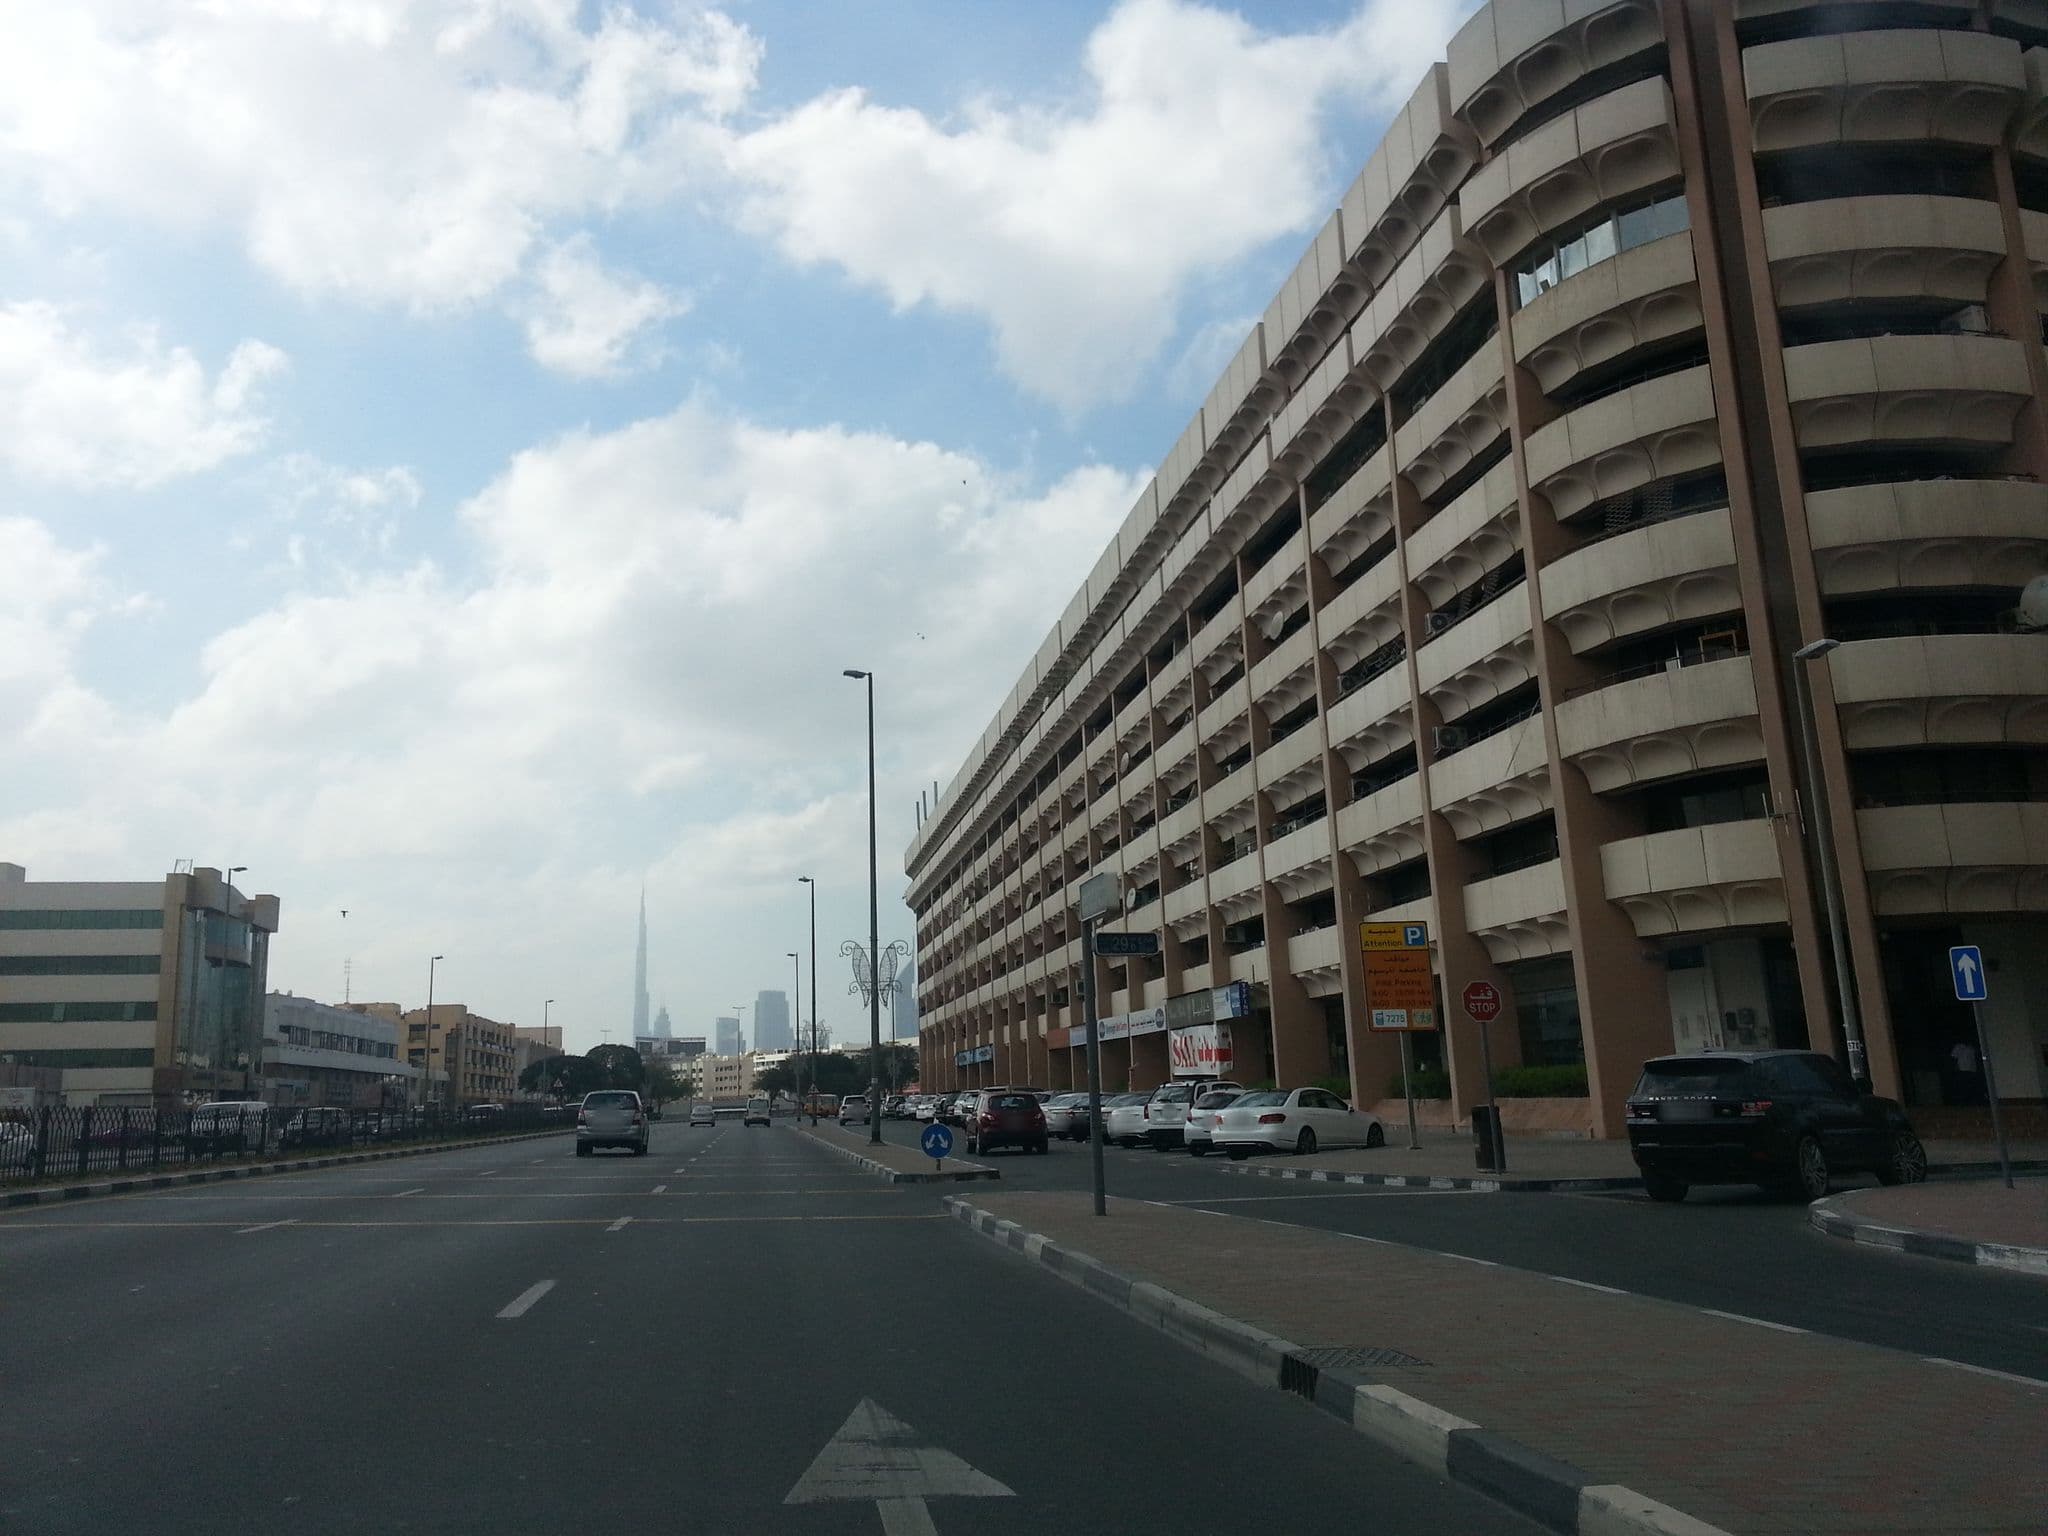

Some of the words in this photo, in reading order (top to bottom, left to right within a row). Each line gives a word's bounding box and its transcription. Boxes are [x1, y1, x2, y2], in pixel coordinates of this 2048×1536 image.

[1407, 927, 1421, 944] P
[1364, 939, 1402, 948] Attention
[1469, 1002, 1496, 1013] STOP
[1385, 1014, 1405, 1024] 7275
[1172, 1035, 1198, 1068] SALE
